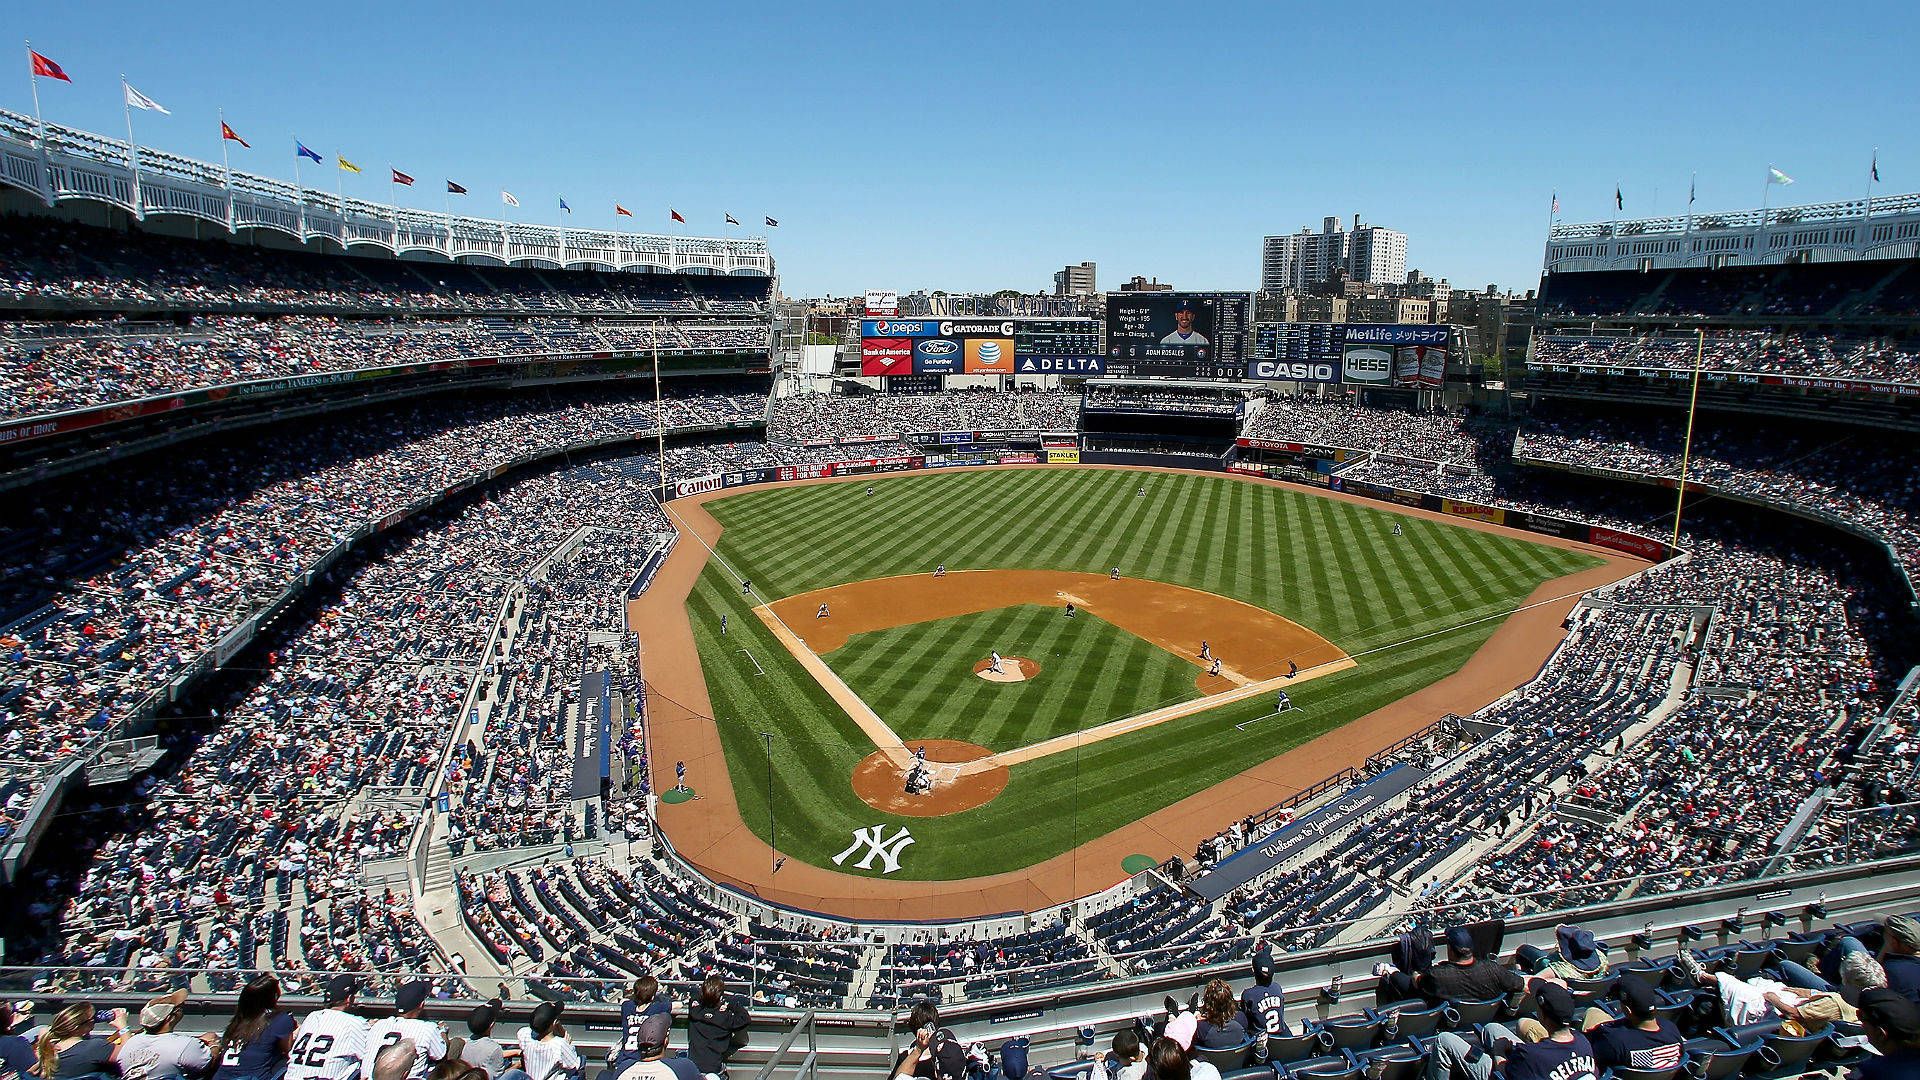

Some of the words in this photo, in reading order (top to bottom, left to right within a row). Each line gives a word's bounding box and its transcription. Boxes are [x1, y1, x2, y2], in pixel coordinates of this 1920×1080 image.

[892, 322, 924, 336] pepsi
[954, 325, 1000, 333] GATORADE
[1346, 328, 1393, 341] MetLife
[1396, 331, 1448, 341] メットライフ
[926, 342, 951, 353] Ford
[1130, 347, 1136, 356] 9
[1145, 349, 1160, 357] ADAM
[1162, 349, 1185, 357] ROSALES
[1041, 359, 1099, 370] DELTA
[1347, 357, 1390, 372] HESS
[1256, 362, 1333, 380] CASIO
[1579, 367, 1598, 375] Boar's
[1607, 368, 1625, 376] Head
[1669, 372, 1690, 380] Head
[1707, 373, 1728, 381] Boar's
[1739, 375, 1759, 383] Head
[1783, 378, 1797, 386] The
[1798, 378, 1811, 387] day
[1813, 379, 1833, 388] after
[1834, 380, 1847, 389] the
[1871, 383, 1891, 393] Score
[1892, 385, 1898, 393] 6
[1899, 386, 1920, 395] Runs
[20, 426, 31, 438] or
[33, 422, 57, 436] more
[1260, 441, 1288, 449] TOYOTA
[1303, 447, 1335, 455] DKNY
[677, 477, 721, 496] Canon
[1618, 539, 1643, 549] America
[1338, 794, 1375, 815] Stadium
[1305, 811, 1343, 836] Yankee
[1301, 826, 1313, 837] to
[832, 823, 916, 874] NY
[1260, 833, 1305, 858] Welcome
[1257, 995, 1281, 1014] JETER
[1265, 1009, 1280, 1033] 2
[291, 1033, 335, 1068] 42
